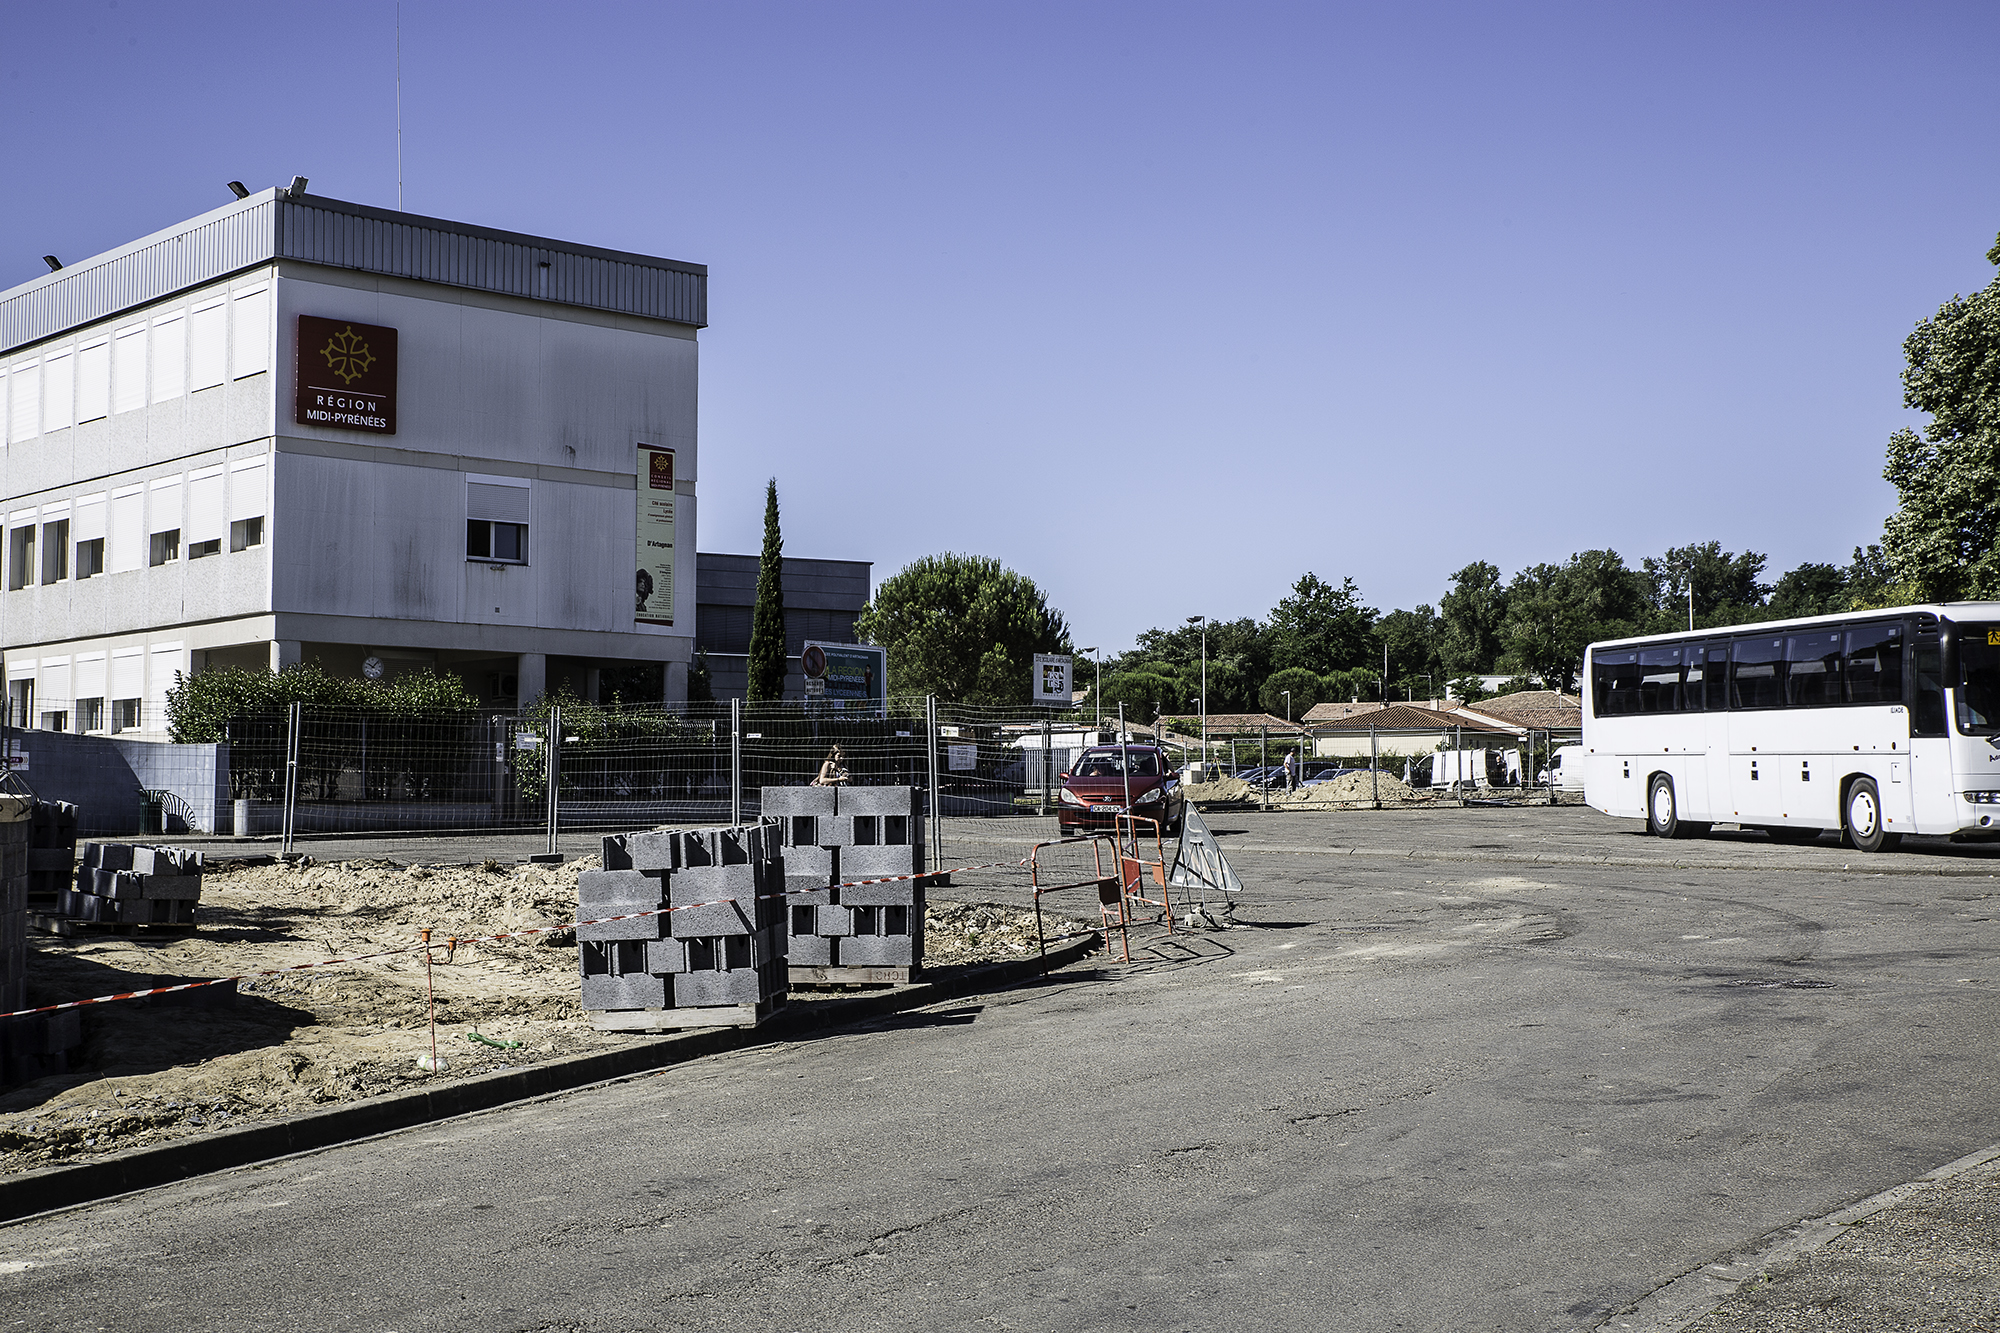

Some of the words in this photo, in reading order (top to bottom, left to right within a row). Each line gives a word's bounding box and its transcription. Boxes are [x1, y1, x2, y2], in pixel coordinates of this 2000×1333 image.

[316, 395, 377, 412] RÉGION
[306, 409, 387, 428] MIDI-PYRÉNÉES
[647, 540, 673, 549] D'Artagnan
